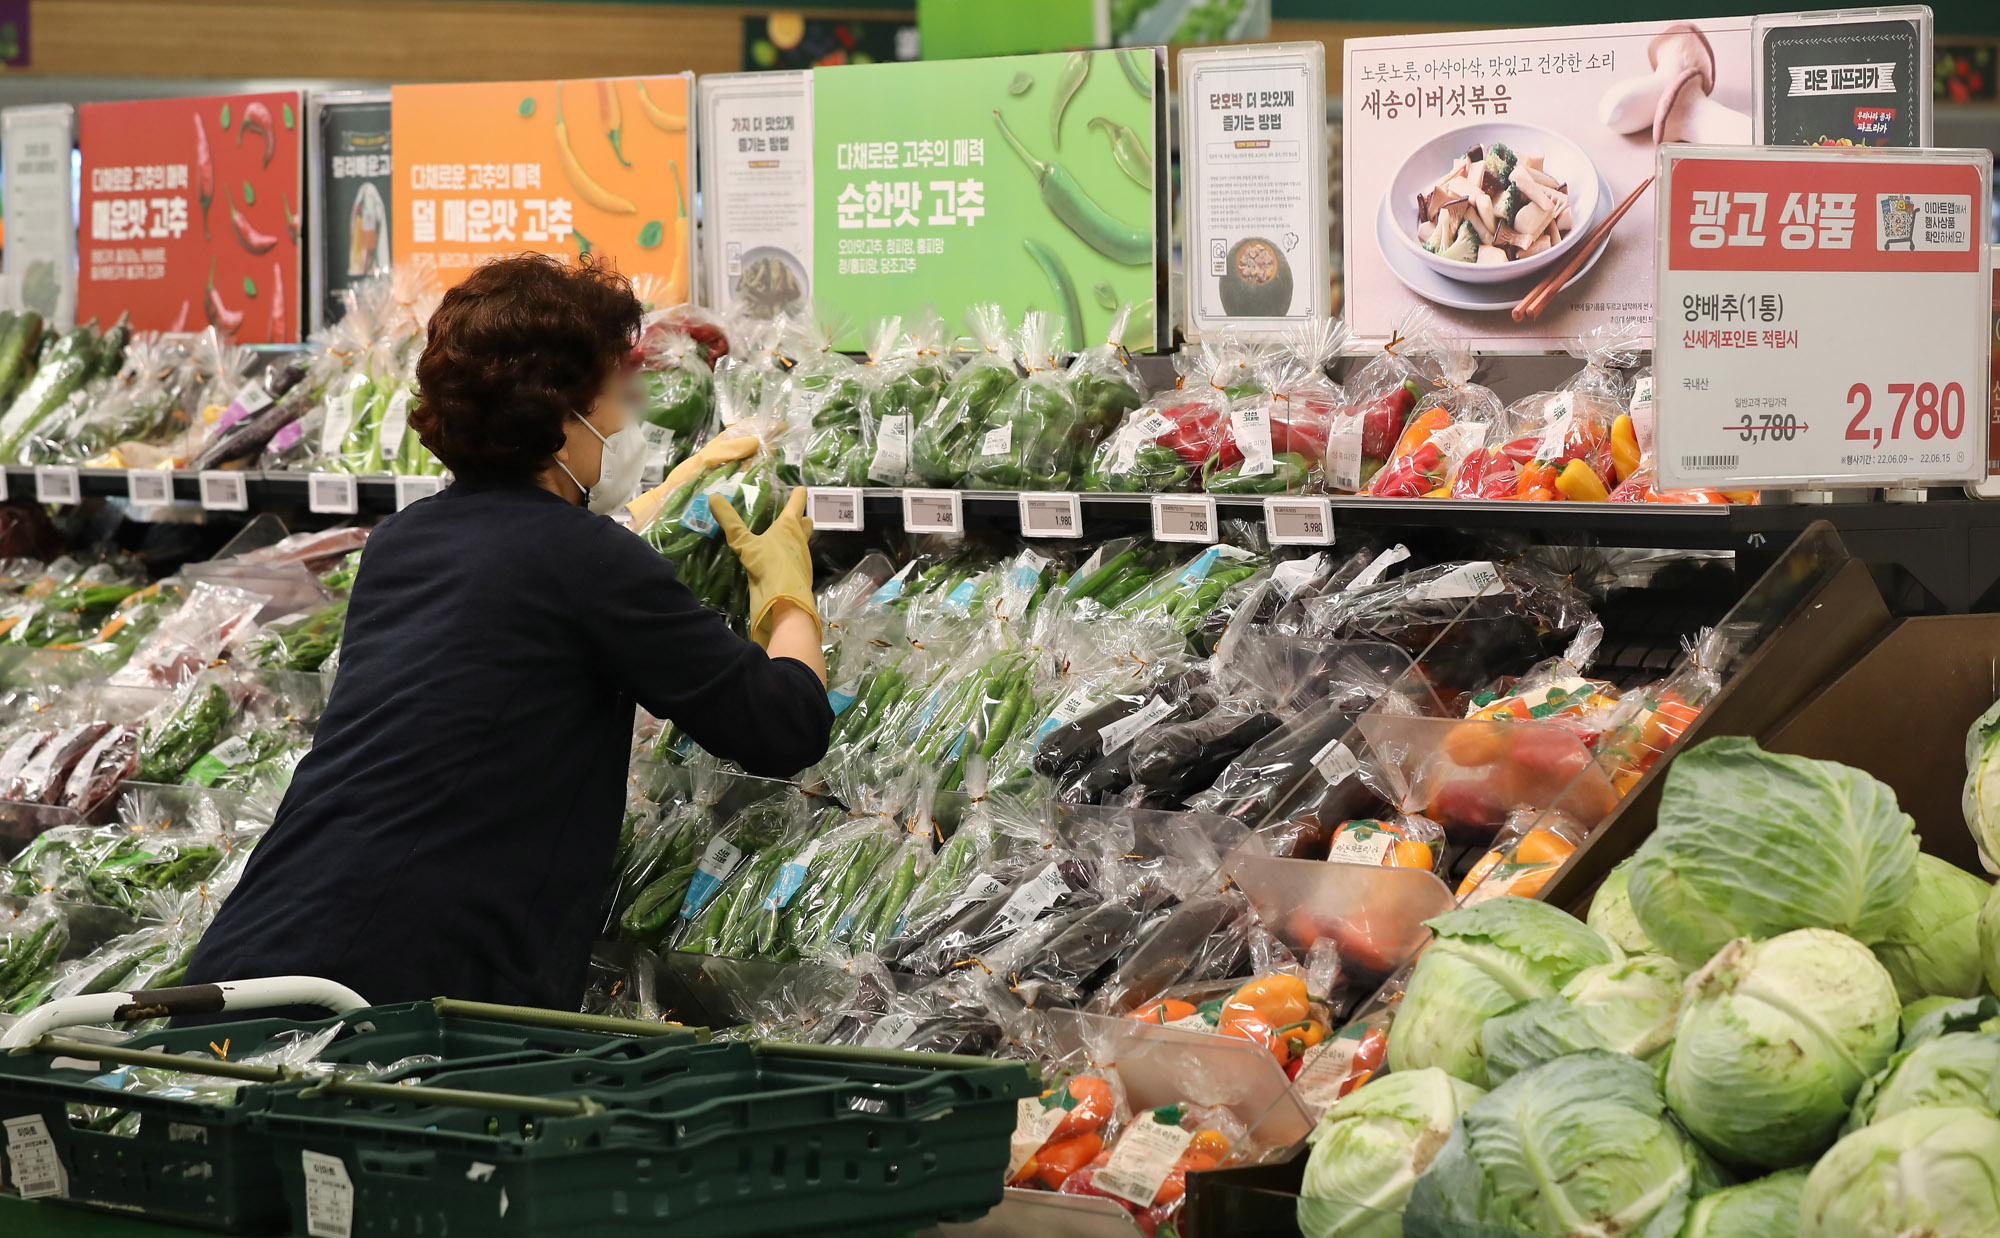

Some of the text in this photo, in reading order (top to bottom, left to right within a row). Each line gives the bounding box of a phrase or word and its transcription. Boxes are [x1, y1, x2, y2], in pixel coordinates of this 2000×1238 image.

[1361, 50, 1616, 83] 노릇노릇, 아삭아삭, 맛있고 건강한 소리
[1804, 67, 1880, 91] 라온 파프리카
[1210, 90, 1294, 110] 단호박 더 맛있게
[1361, 84, 1512, 120] 새송이버섯볶음
[732, 116, 794, 132] 가지 더 맛있게
[1223, 113, 1282, 132] 즐기는 방법
[1857, 111, 1892, 122] 우리나라 종자
[1857, 122, 1888, 134] 파프리카
[738, 136, 790, 152] 즐기는 방법
[837, 138, 985, 171] 다채로운 고추의 매력
[92, 166, 133, 193] 다채로운
[134, 164, 166, 192] 고추의
[411, 162, 541, 191] 다채로운 고추의 매력
[837, 180, 923, 229] 순한맛
[928, 178, 986, 227] 고추
[1924, 202, 1967, 214] 이마트앱에서
[92, 196, 189, 241] 매운맛 고추
[412, 197, 574, 244] 덜 매운맛 고추
[1689, 190, 1858, 250] 광고 상품
[1925, 216, 1955, 229] 행사상품
[1925, 230, 1966, 244] 확인하세요!
[838, 239, 885, 255] 오이맛고추,
[881, 257, 917, 274] 당조고추
[1682, 294, 1784, 322] 양배추(1통)
[1682, 330, 1798, 349] 신세계포인트 적립시
[1682, 378, 1709, 391] 국내산
[1734, 397, 1787, 408] 일반고객 구입가격
[1844, 382, 1966, 450] 2,780
[1740, 414, 1797, 446] 3,780
[1878, 454, 1908, 464] 22.06.09
[1920, 454, 1950, 464] 22.06.15
[712, 854, 728, 864] 그대로
[718, 848, 730, 858] 신선
